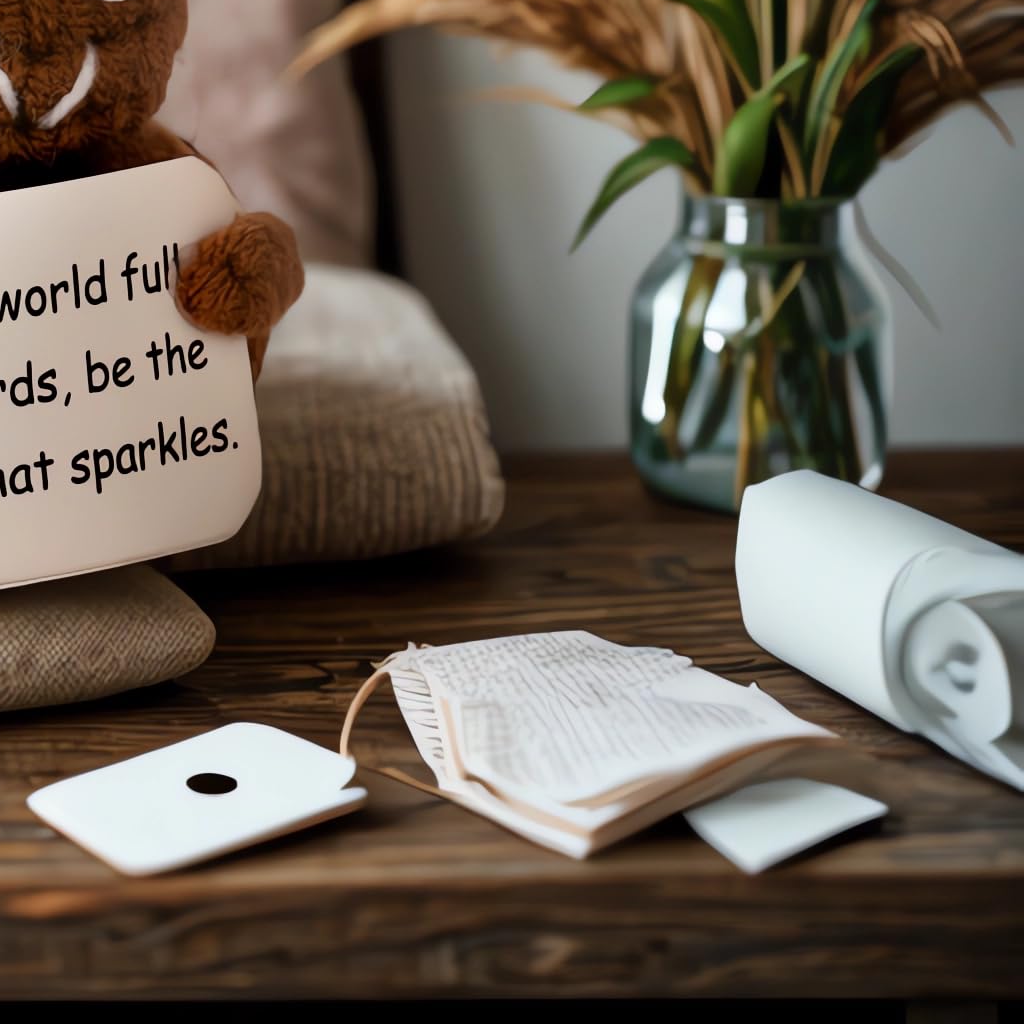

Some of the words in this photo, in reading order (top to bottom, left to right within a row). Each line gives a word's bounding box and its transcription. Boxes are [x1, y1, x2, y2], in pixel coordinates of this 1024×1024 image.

[85, 349, 135, 394] be
[145, 331, 209, 381] the
[70, 415, 240, 495] sparkles.
